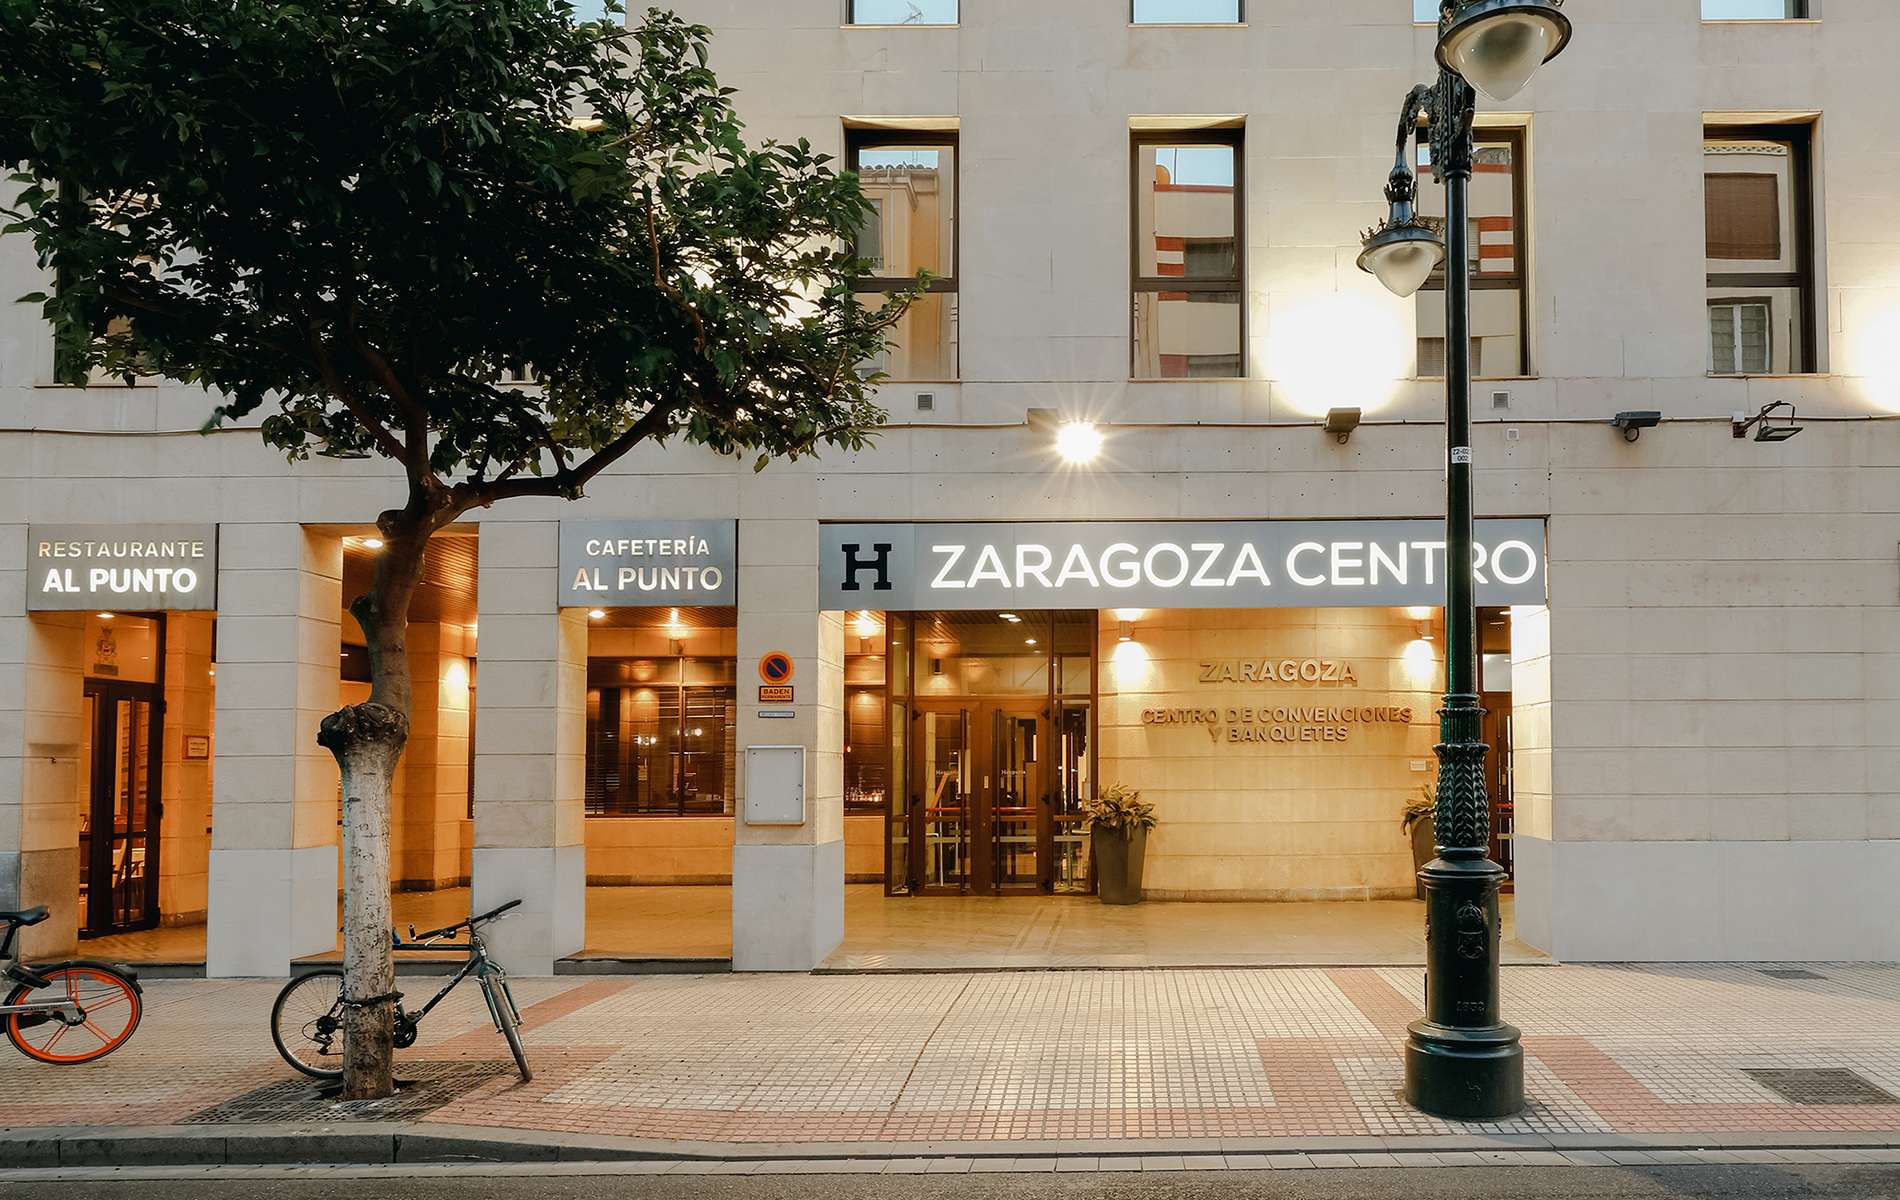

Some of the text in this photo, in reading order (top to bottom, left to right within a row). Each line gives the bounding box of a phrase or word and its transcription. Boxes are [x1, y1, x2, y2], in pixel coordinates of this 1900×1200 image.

[38, 541, 204, 558] RESTAURANTE
[586, 535, 710, 556] CAFETERÍA
[841, 543, 892, 590] H
[930, 543, 1271, 588] ZARAGOZA
[42, 567, 197, 593] AL PUNTO
[572, 566, 723, 591] AL PUNTO
[1200, 659, 1357, 683] ZARAGOZA
[1142, 706, 1413, 724] CENTRO DE CONVENCIONES
[1209, 726, 1348, 742] Y BANQUETES
